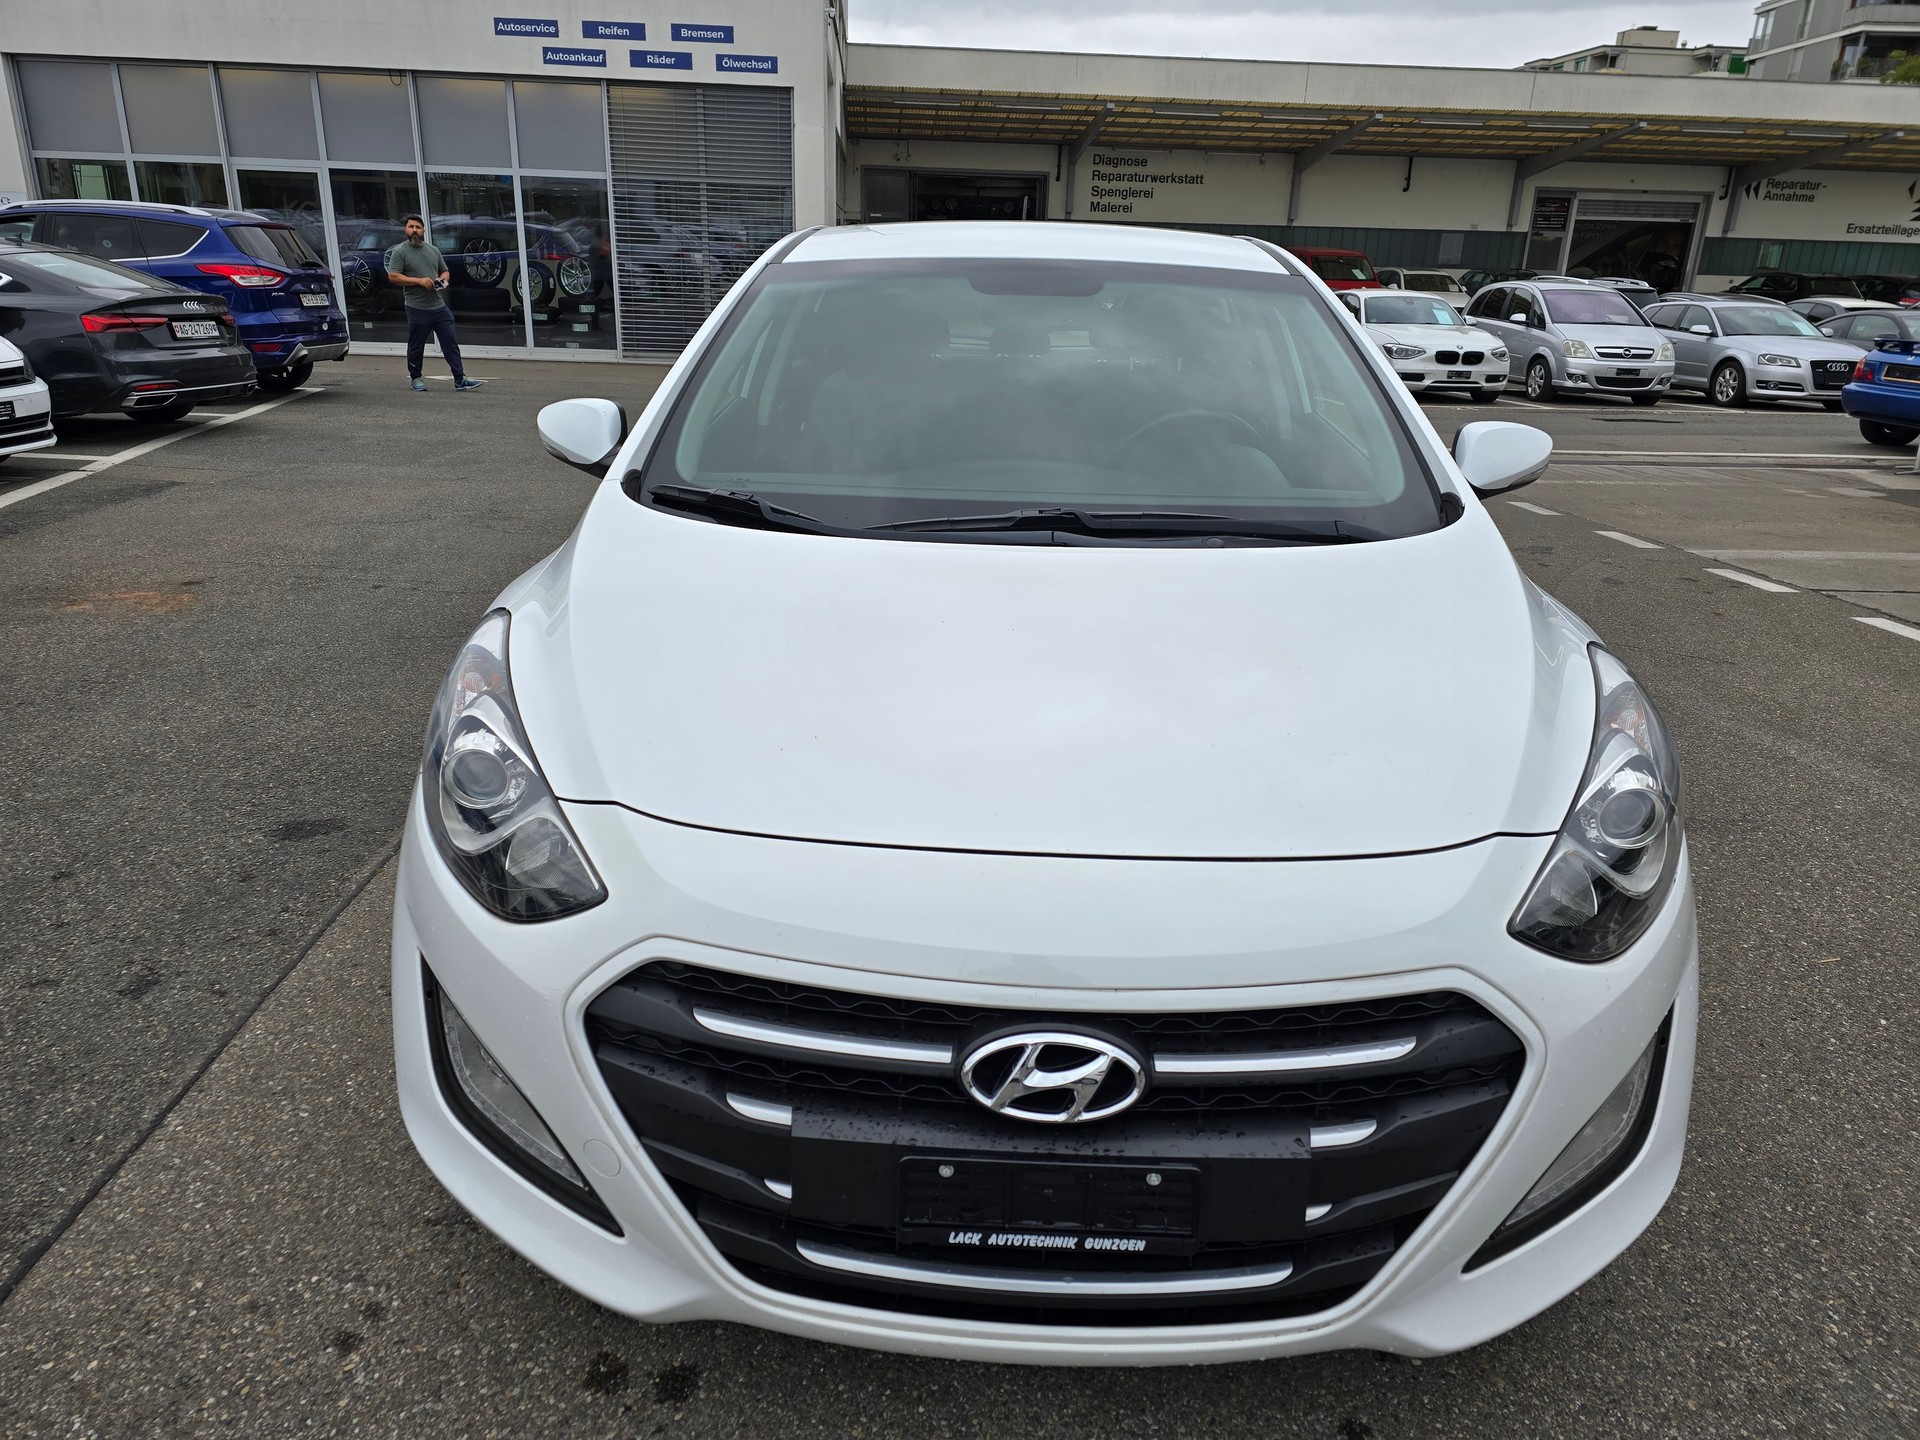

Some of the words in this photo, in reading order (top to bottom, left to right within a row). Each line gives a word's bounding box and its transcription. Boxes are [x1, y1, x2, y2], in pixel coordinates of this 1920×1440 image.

[497, 21, 556, 34] Autoservice
[598, 25, 630, 36] Reifen
[681, 28, 724, 39] Bremsen
[546, 51, 604, 64] Autoankauf
[646, 54, 675, 66] Räder
[722, 57, 772, 70] Ölwechsel
[1092, 154, 1148, 168] Diagnose
[1091, 170, 1205, 185] Reparaturwerkstatt
[1765, 178, 1828, 192] Reparatur-
[1091, 185, 1154, 200] Spenglerei
[1763, 190, 1815, 203] Annahme
[1090, 201, 1133, 213] Malerei
[1846, 223, 1920, 238] Ersatzteillage
[948, 1231, 982, 1246] LACK
[988, 1233, 1078, 1250] AUTOTECHNIK
[1084, 1237, 1146, 1252] GUNZGEN
